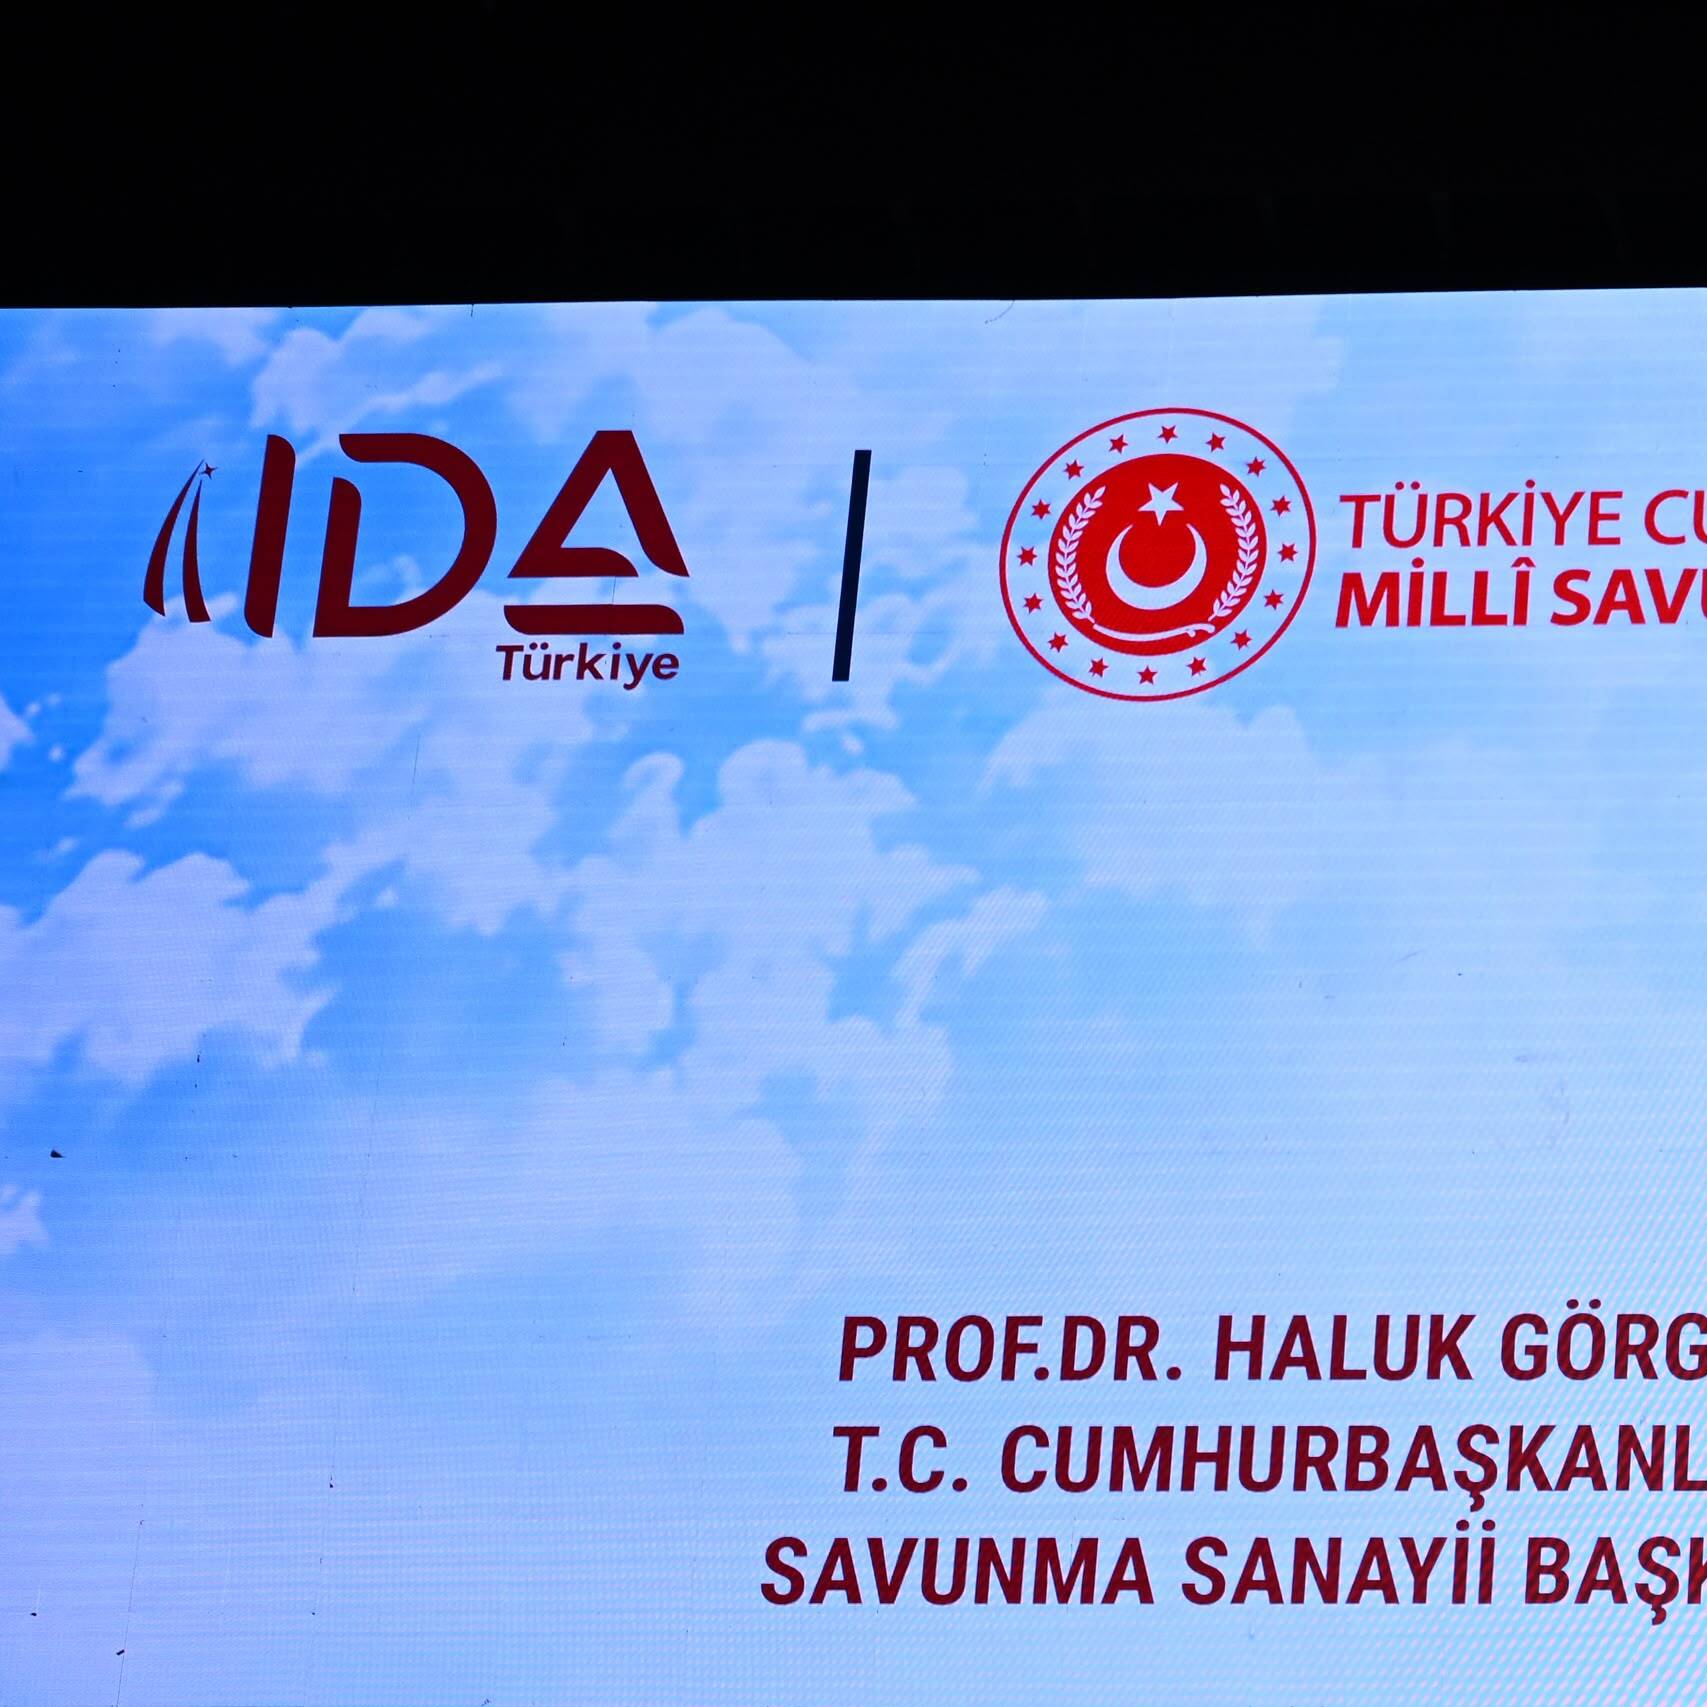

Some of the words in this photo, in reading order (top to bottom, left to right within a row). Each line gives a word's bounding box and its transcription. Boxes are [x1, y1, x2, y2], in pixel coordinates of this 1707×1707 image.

[1339, 480, 1624, 548] TÜRKİYE
[1335, 557, 1537, 628] MİLLÎ
[496, 642, 680, 691] Türkiye
[839, 1315, 1182, 1382] PROF.DR.
[1214, 1314, 1477, 1380] HALUK
[833, 1425, 968, 1493] T.C.
[761, 1536, 1154, 1605] SAVUNMA
[1182, 1520, 1496, 1605] SANAYİİ
